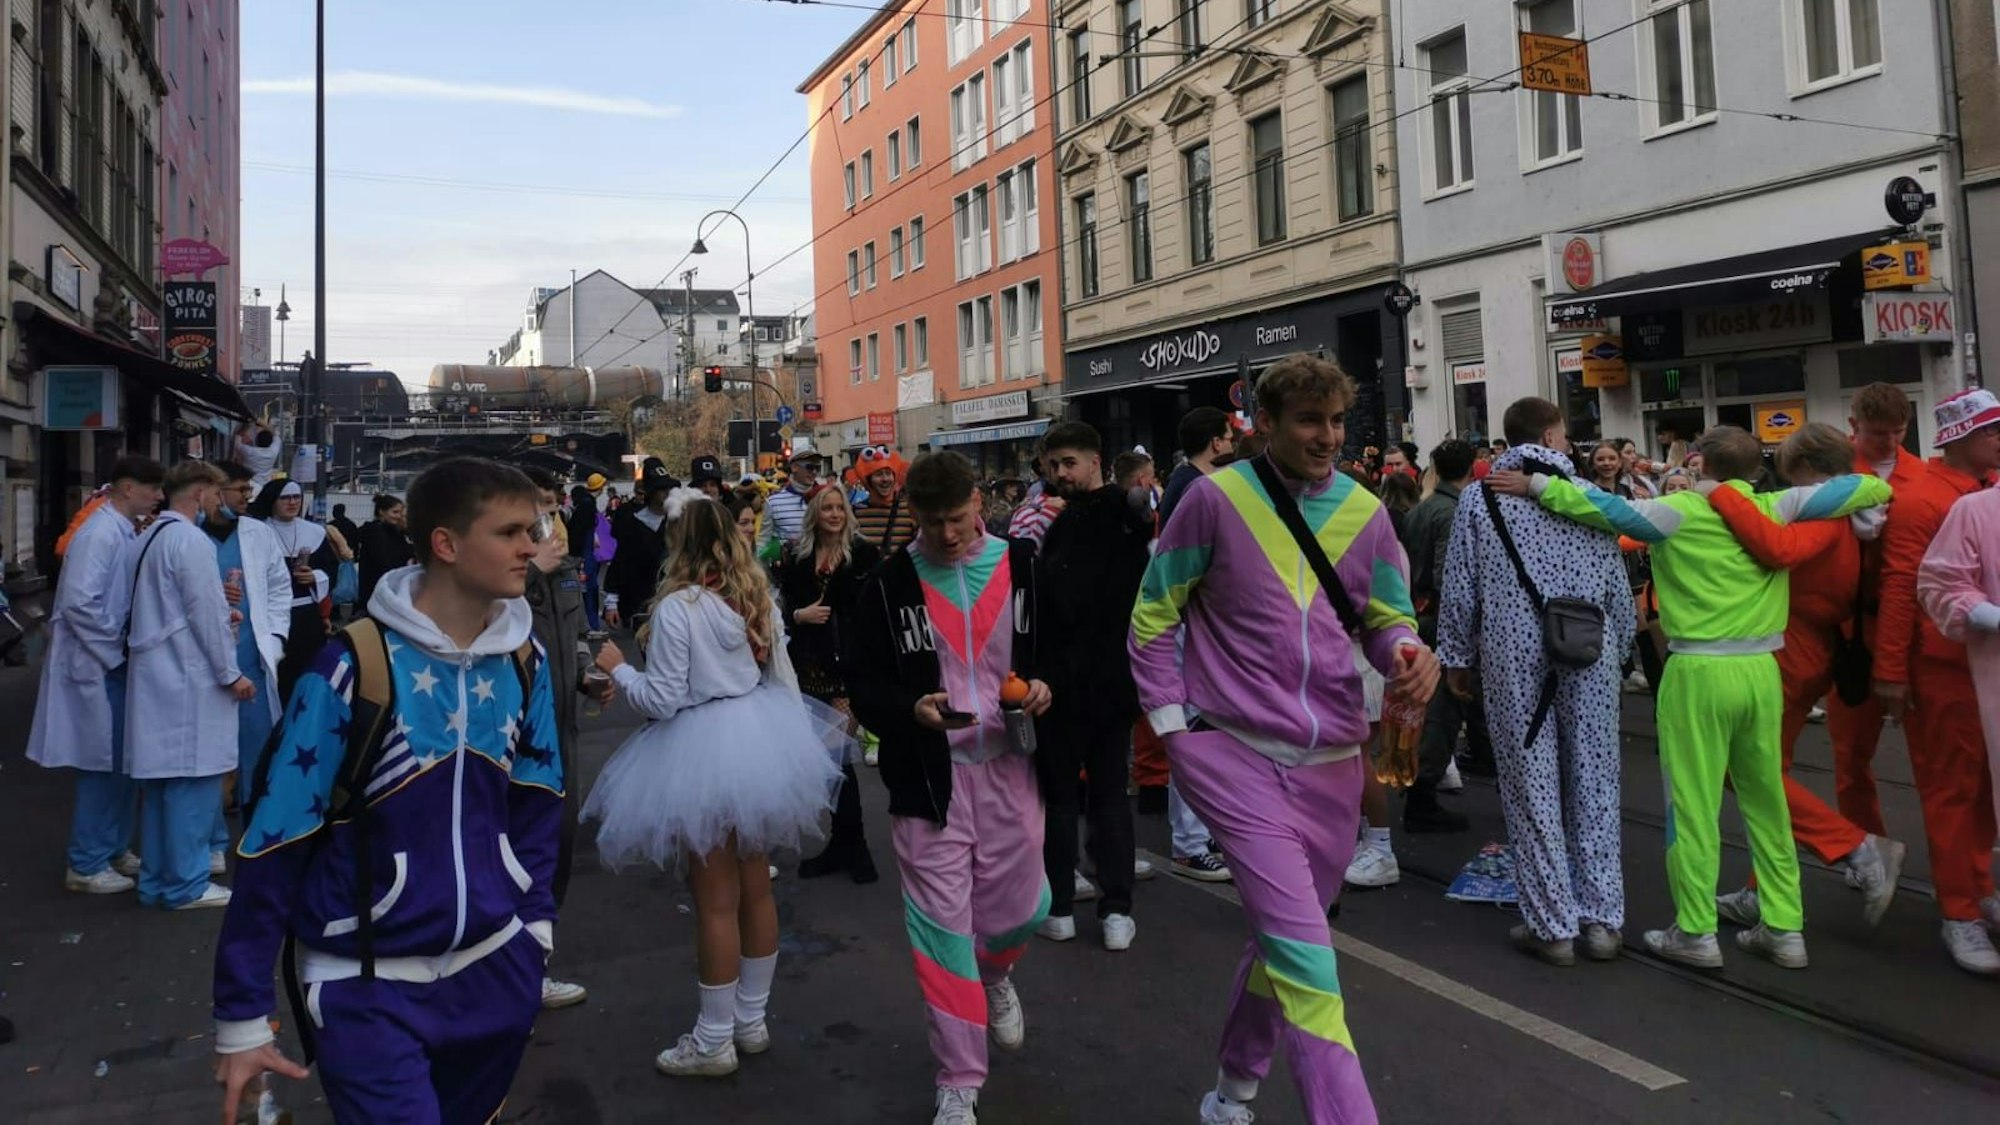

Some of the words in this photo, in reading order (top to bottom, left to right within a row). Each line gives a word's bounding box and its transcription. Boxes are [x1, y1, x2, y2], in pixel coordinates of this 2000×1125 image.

[165, 287, 216, 308] GYROS
[175, 307, 207, 319] PITA
[1696, 305, 1761, 338] Kiosk
[1876, 301, 1953, 332] KIOSK
[1256, 324, 1297, 346] Ramen
[1090, 356, 1113, 376] Sushi
[988, 393, 1027, 410] DAMASKUS
